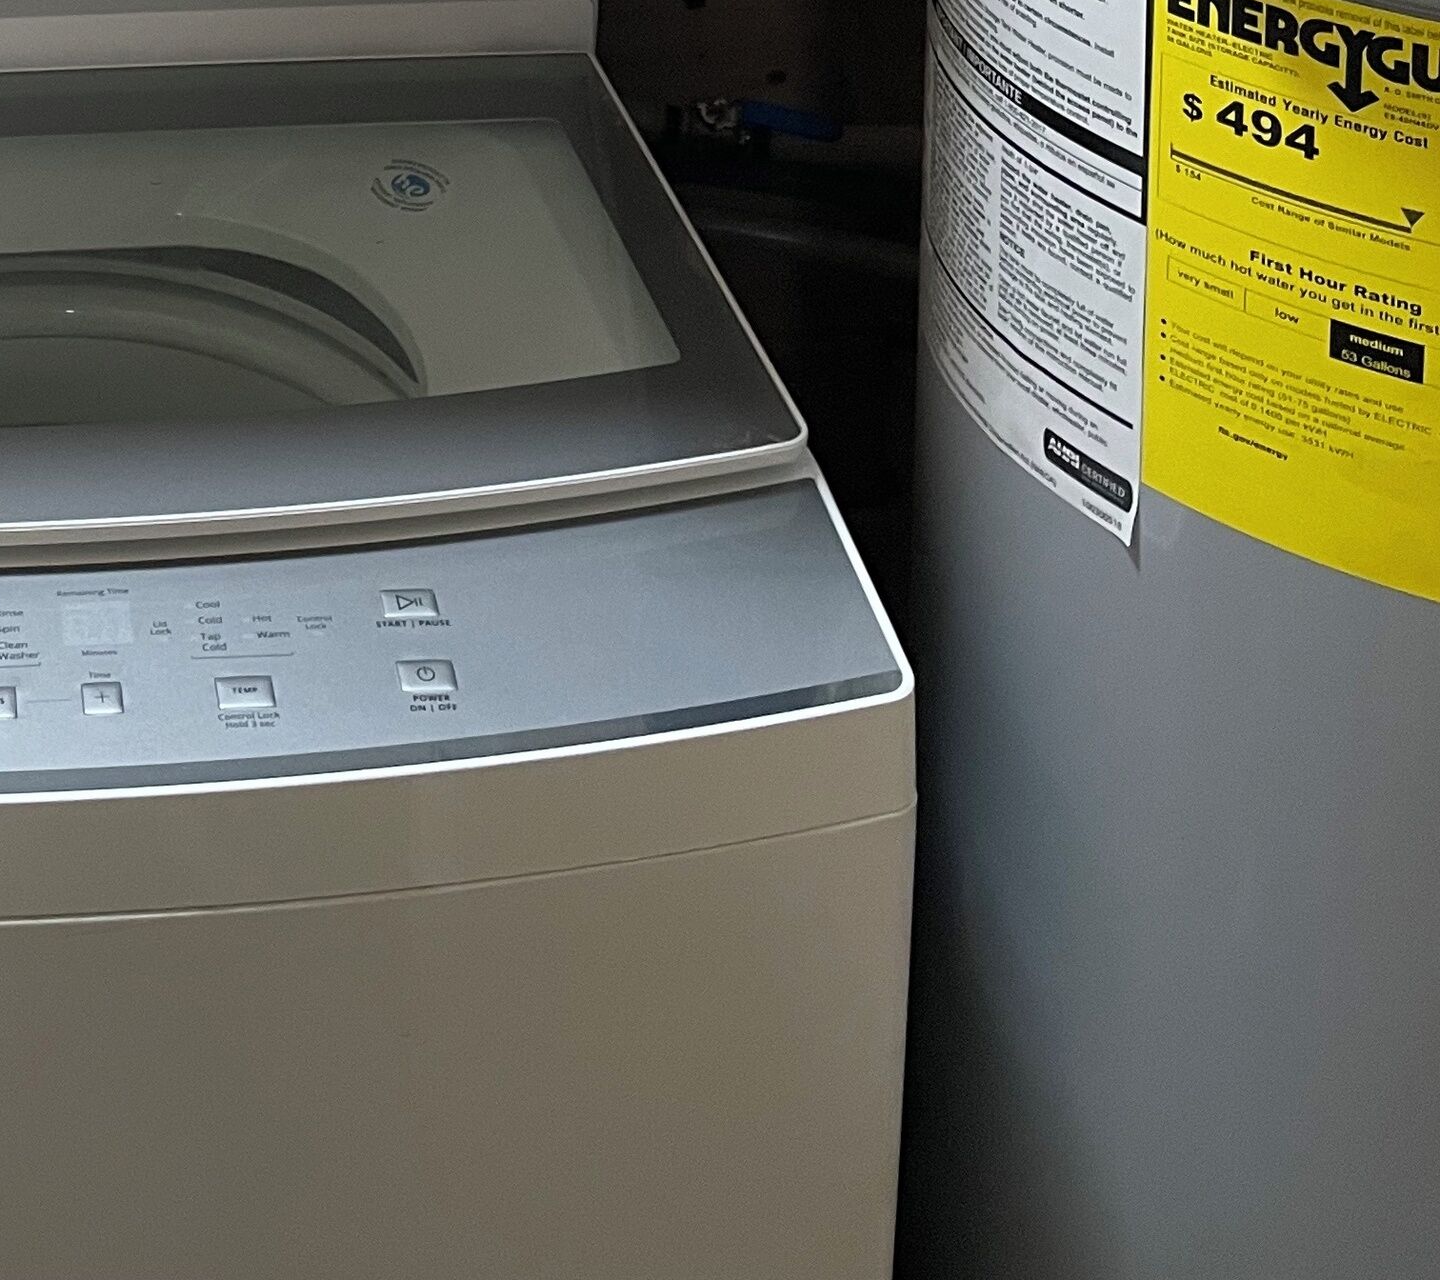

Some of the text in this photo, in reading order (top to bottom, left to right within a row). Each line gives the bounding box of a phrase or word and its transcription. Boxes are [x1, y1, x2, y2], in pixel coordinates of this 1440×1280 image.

[1210, 74, 1276, 107] Estimated
[1282, 98, 1329, 124] Yearly
[1334, 115, 1388, 140] Energy
[1394, 131, 1428, 148] Cost
[1182, 93, 1320, 160] $ 494
[1251, 197, 1411, 251] Cost Range of Similar Models
[1155, 228, 1440, 336] (How much hot water you get in the first
[1177, 270, 1234, 299] very small
[1250, 250, 1423, 317] First Hour Rating
[1275, 307, 1299, 324] low
[1350, 334, 1404, 357] medium
[1361, 355, 1411, 378] Gallons
[196, 601, 220, 609] Cool
[198, 616, 223, 624] Cold
[252, 615, 272, 623] Hot
[201, 633, 221, 642] Tap
[202, 643, 227, 651] Cold
[218, 712, 279, 721] Control Lock
